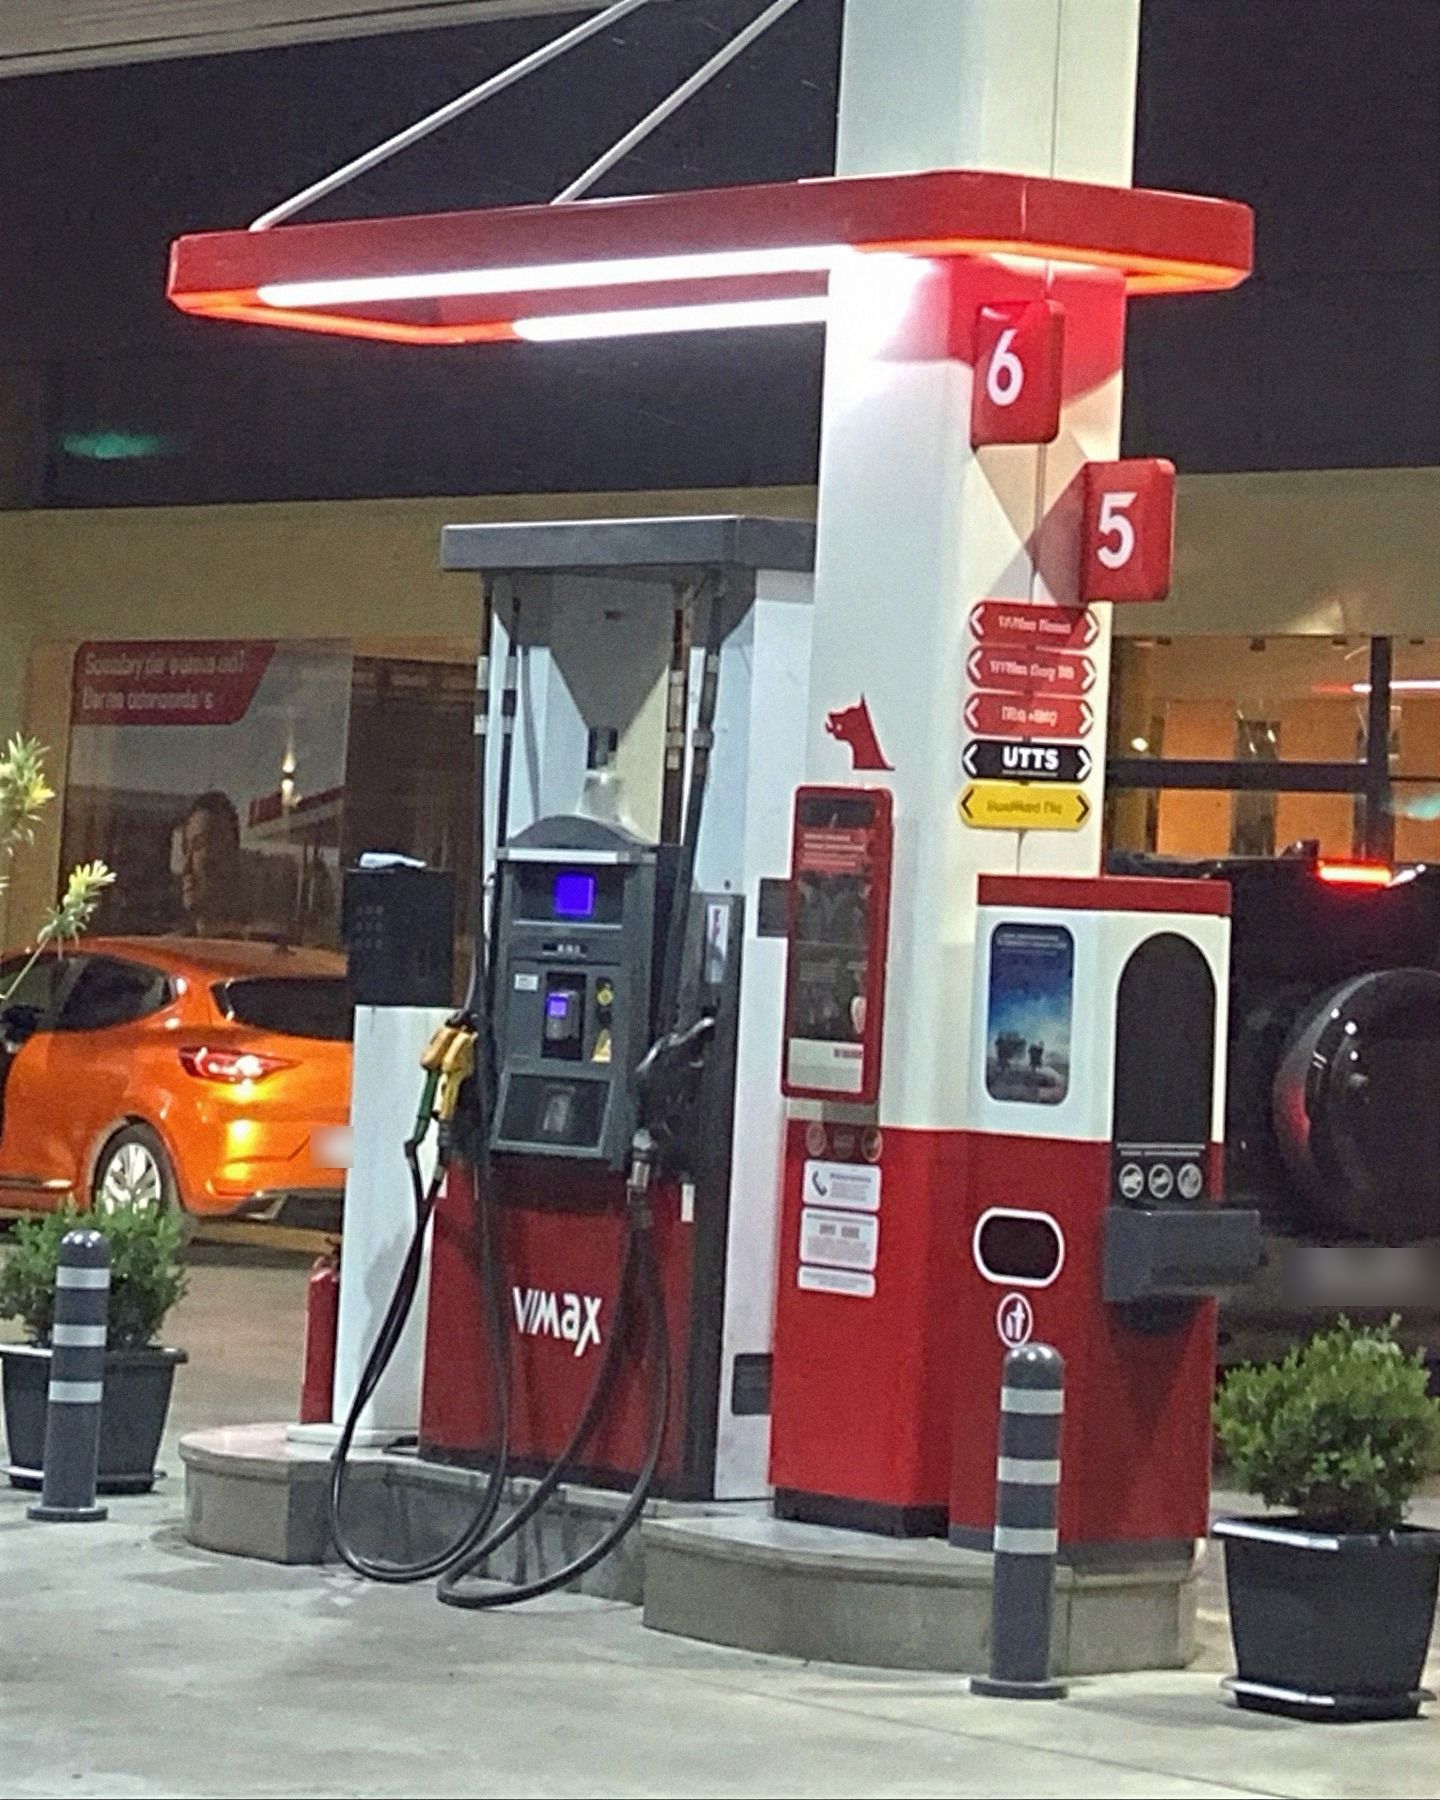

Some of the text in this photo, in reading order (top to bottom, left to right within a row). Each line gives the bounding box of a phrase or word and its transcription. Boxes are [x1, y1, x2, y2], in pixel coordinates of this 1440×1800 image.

[986, 328, 1024, 406] 6
[1097, 491, 1138, 569] 5
[1002, 745, 1060, 771] UTTS
